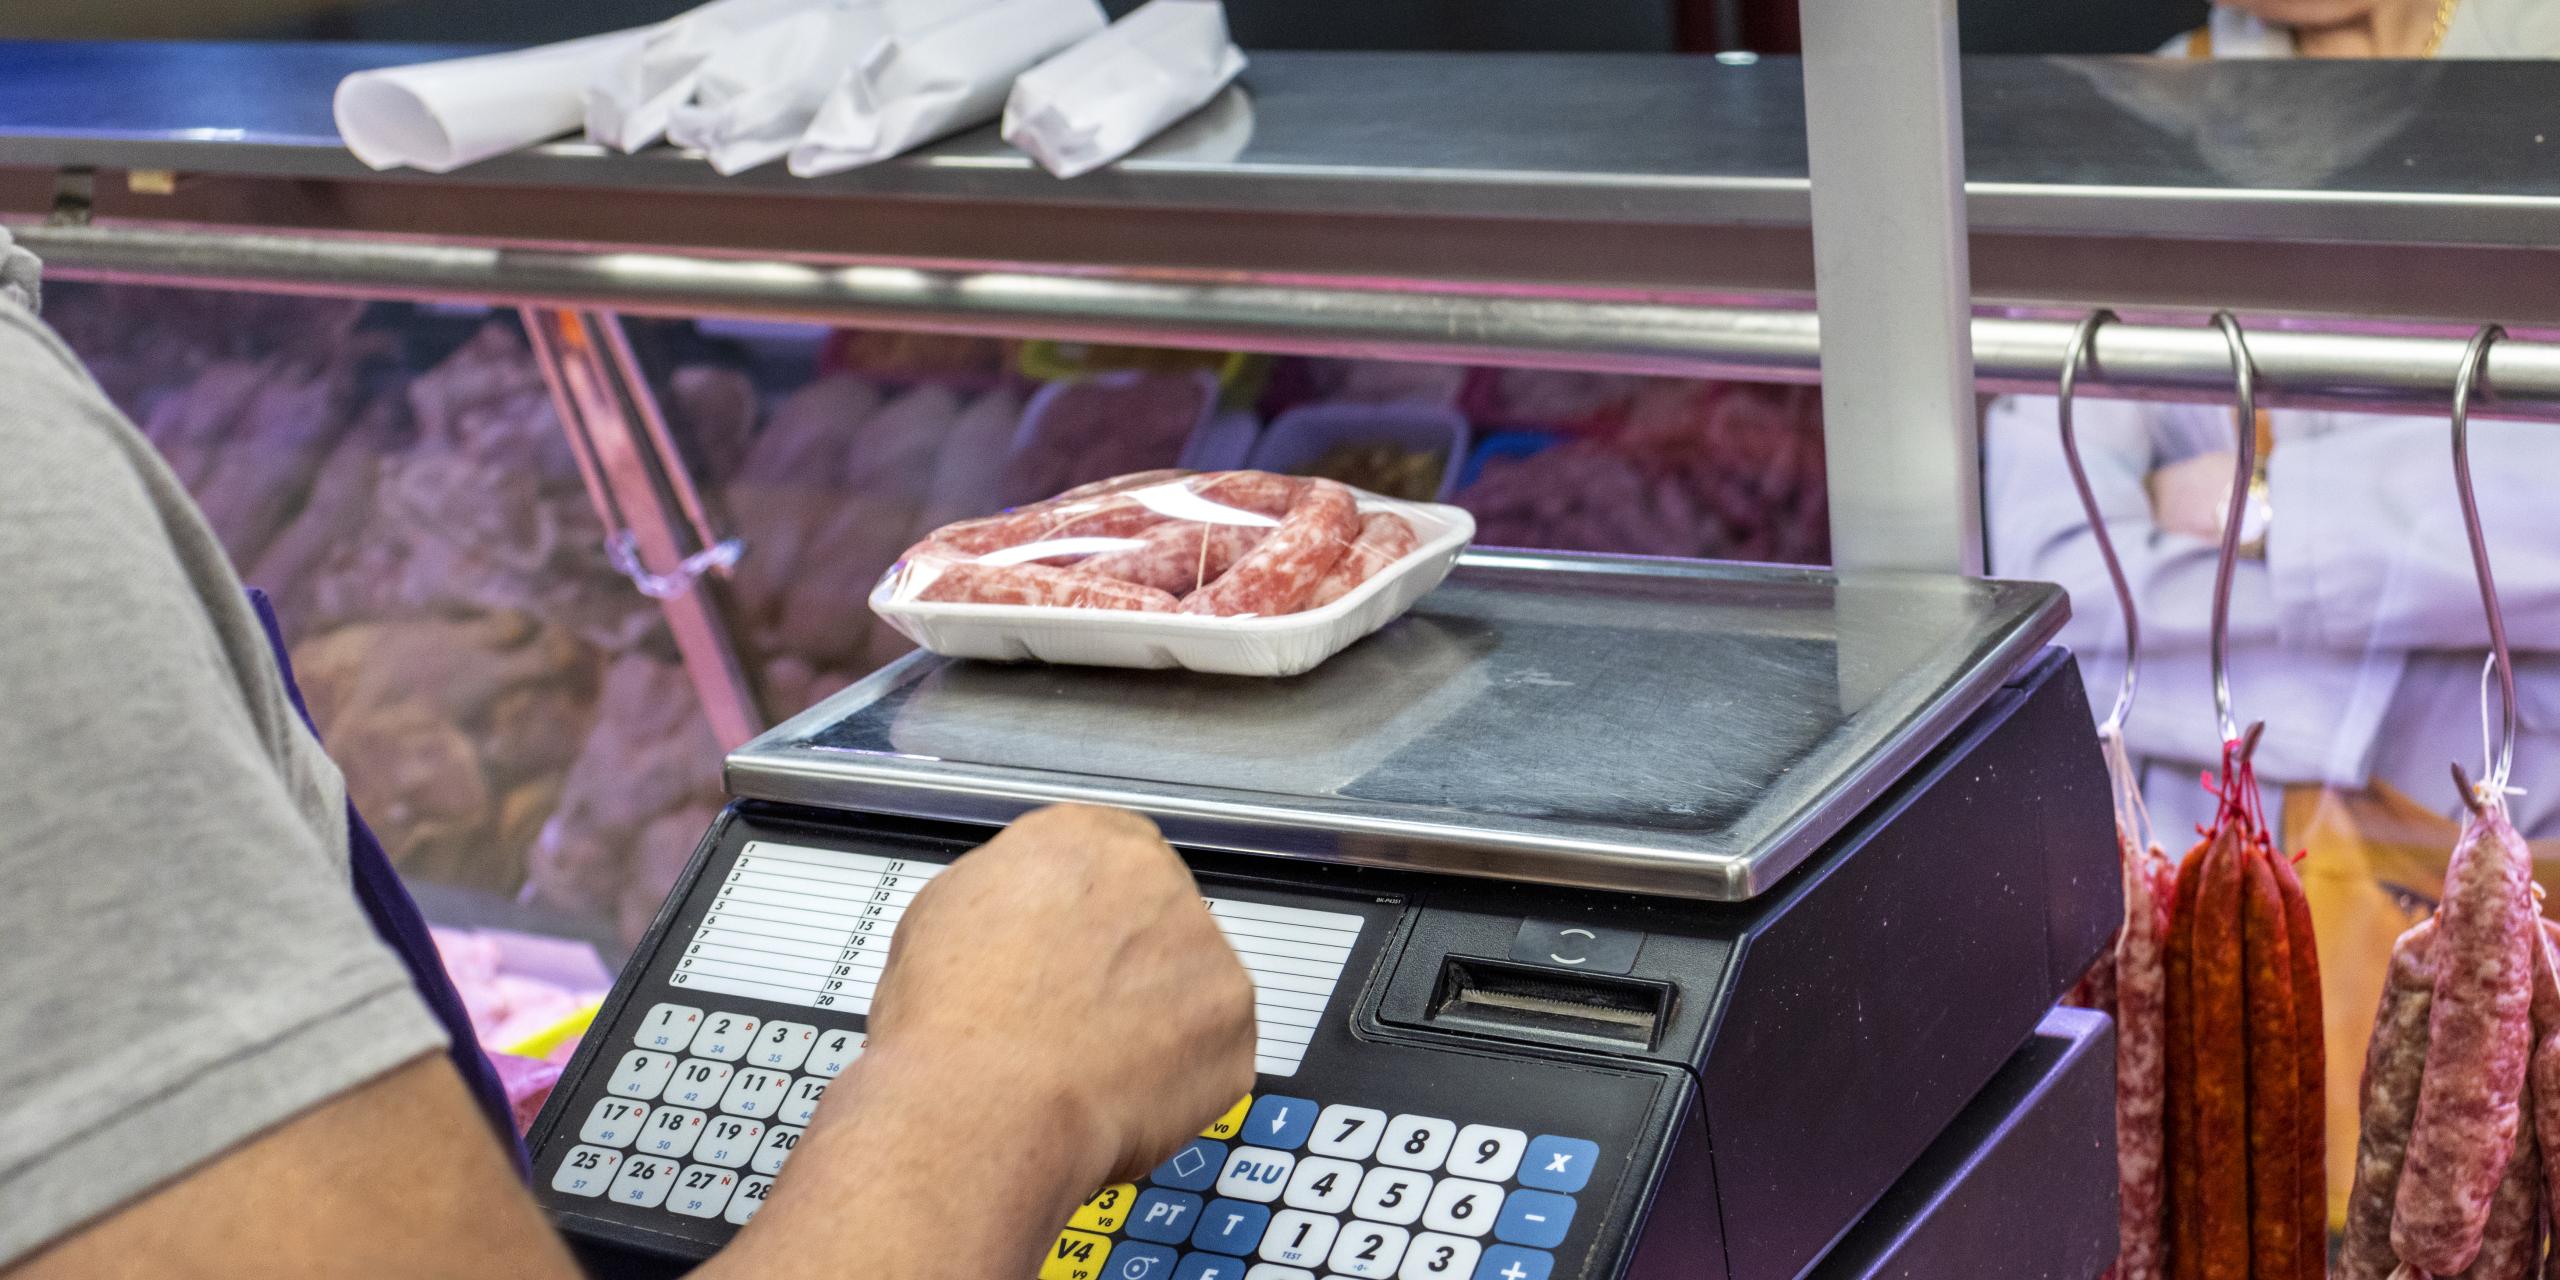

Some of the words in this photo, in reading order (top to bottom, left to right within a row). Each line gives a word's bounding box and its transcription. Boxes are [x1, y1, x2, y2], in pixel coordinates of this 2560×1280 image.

[748, 844, 756, 852] 1
[739, 859, 749, 867] 2
[890, 862, 904, 872] 11
[732, 873, 740, 881] 3
[882, 877, 897, 886] 12
[724, 887, 733, 896] 4
[874, 892, 889, 901] 13
[715, 901, 724, 910] 5
[867, 906, 882, 916] 14
[707, 915, 716, 924] 6
[858, 921, 874, 931] 15
[700, 931, 709, 939] 7
[851, 936, 865, 945] 16
[691, 944, 700, 953] 8
[842, 950, 859, 960] 17
[684, 959, 692, 968] 9
[835, 965, 850, 975] 18
[673, 974, 688, 983] 10
[827, 980, 842, 990] 19
[817, 996, 834, 1006] 20
[662, 1011, 672, 1025] 1
[688, 1014, 696, 1022] A
[715, 1019, 730, 1034] 2
[654, 1036, 668, 1045] 33
[772, 1028, 787, 1044] 3
[711, 1045, 725, 1054] 34
[830, 1037, 846, 1052] 4
[768, 1054, 782, 1063] 35
[634, 1057, 648, 1072] 9
[826, 1063, 840, 1072] 36
[685, 1065, 710, 1082] 10
[719, 1070, 727, 1078] J
[627, 1083, 640, 1092] 41
[743, 1074, 766, 1091] 11
[776, 1079, 785, 1087] K
[684, 1093, 698, 1101] 42
[801, 1083, 825, 1101] 12
[742, 1102, 755, 1111] 43
[602, 1104, 629, 1120] 17
[634, 1108, 643, 1117] Q
[659, 1113, 684, 1131] 18
[692, 1118, 700, 1126] R
[715, 1122, 742, 1140] 19
[751, 1128, 758, 1136] S
[1213, 1123, 1229, 1134] V0
[1334, 1119, 1365, 1142] 7
[601, 1131, 614, 1140] 49
[657, 1140, 671, 1150] 50
[772, 1132, 800, 1150] 20
[1404, 1129, 1430, 1154] 8
[715, 1150, 727, 1159] 51
[1476, 1139, 1500, 1164] 9
[572, 1152, 600, 1169] 25
[609, 1157, 616, 1165] Y
[628, 1162, 655, 1179] 26
[664, 1167, 673, 1175] Z
[1230, 1160, 1284, 1186] PLU
[573, 1180, 587, 1188] 57
[686, 1172, 716, 1189] 27
[1311, 1173, 1339, 1197] 4
[630, 1190, 643, 1199] 58
[744, 1182, 772, 1200] 28
[1379, 1183, 1408, 1208] 5
[1084, 1187, 1119, 1210] V3
[688, 1201, 702, 1209] 59
[1451, 1194, 1477, 1219] 6
[1145, 1202, 1186, 1226] PT
[1097, 1217, 1113, 1227] V8
[1222, 1214, 1245, 1235] T
[1291, 1223, 1313, 1248] 1
[1057, 1238, 1094, 1263] V4
[1356, 1234, 1383, 1260] 2
[1282, 1251, 1302, 1260] TEST
[1428, 1246, 1455, 1272] 3
[1072, 1269, 1087, 1280] V9
